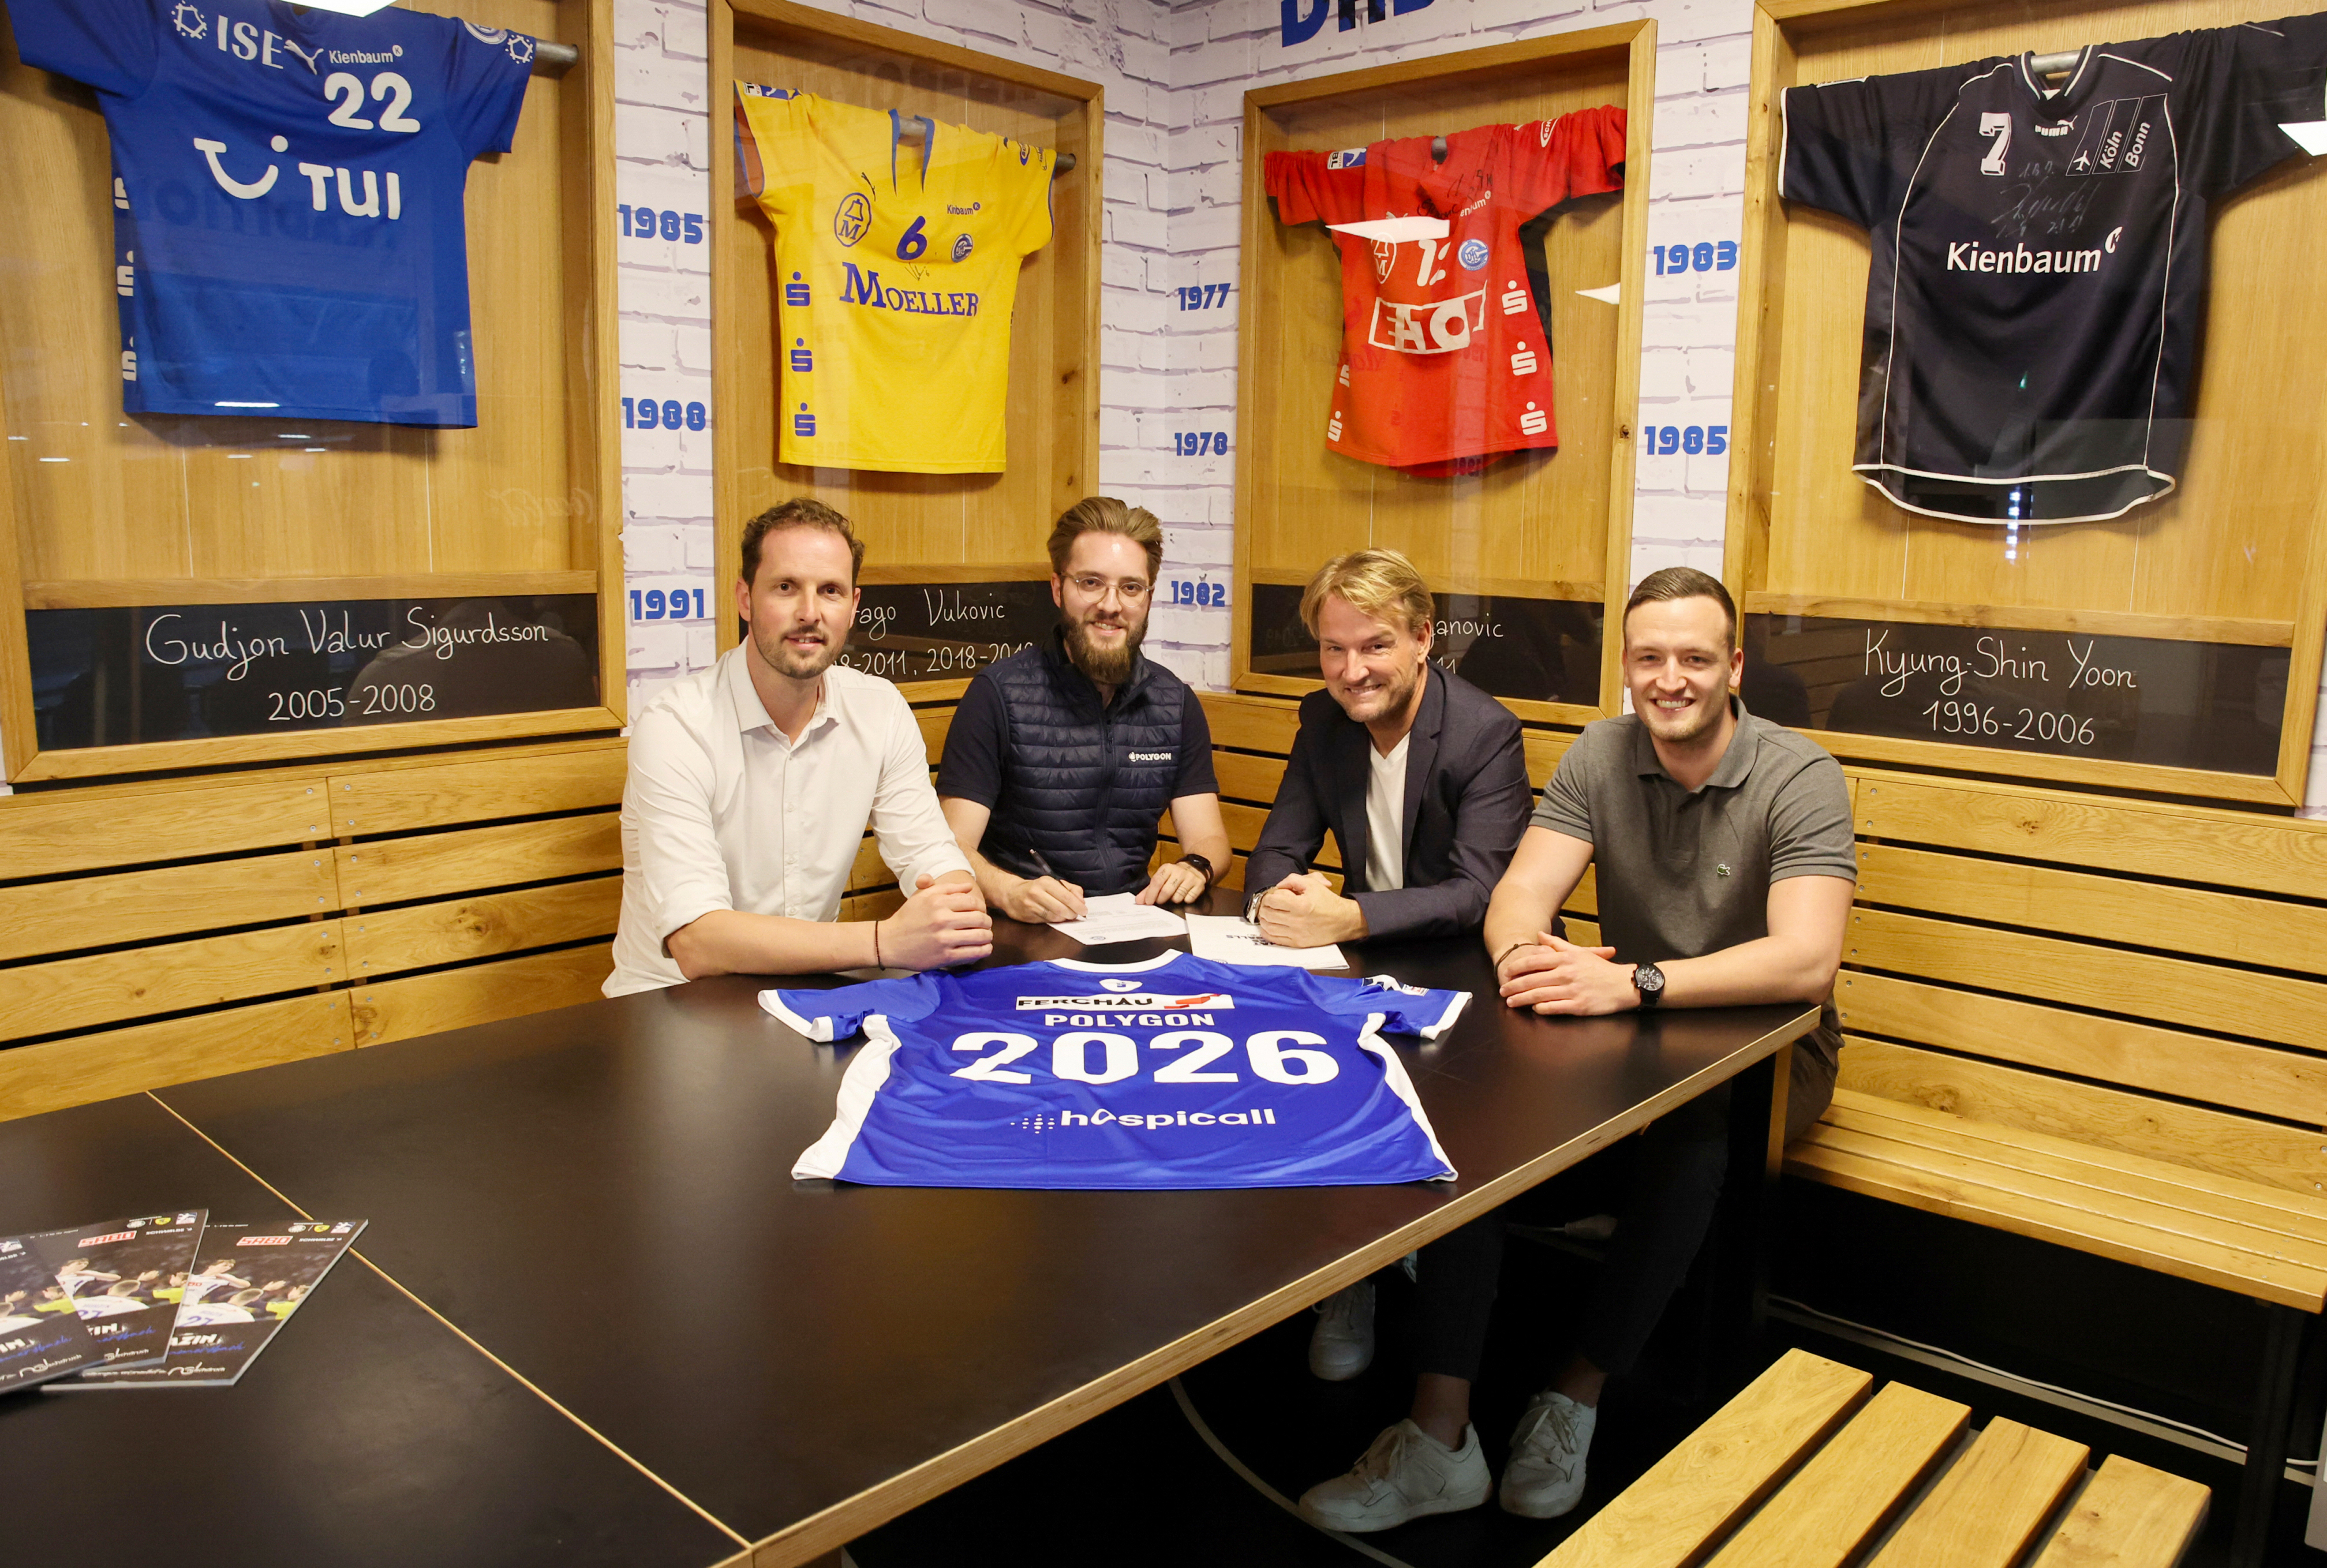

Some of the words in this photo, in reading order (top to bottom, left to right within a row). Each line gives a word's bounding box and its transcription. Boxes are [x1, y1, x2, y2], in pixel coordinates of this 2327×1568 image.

[217, 14, 283, 70] ISE
[328, 50, 394, 64] Kienbaum
[324, 72, 421, 133] 22
[1979, 112, 2011, 176] 7
[2099, 130, 2123, 169] Köln
[2124, 121, 2151, 167] Bonn
[298, 162, 401, 220] TUI
[619, 203, 703, 245] 1985
[896, 215, 927, 261] 6
[1653, 240, 1737, 275] 1983
[1946, 241, 2102, 274] Kienbaum
[839, 261, 979, 317] MOELLER
[1178, 283, 1231, 312] 1977
[622, 397, 706, 432] 1988
[1174, 432, 1228, 456] 1978
[1644, 425, 1728, 455] 1985
[629, 588, 705, 620] 1991
[924, 588, 1006, 627] Vukovic
[1171, 580, 1225, 608] 1982
[146, 613, 290, 682] Gudjon
[300, 609, 391, 655] Valur
[402, 607, 549, 660] Sigurdsson
[1865, 627, 2049, 698] Kyung-Shin
[2067, 639, 2137, 689] Yoon
[268, 683, 436, 721] 2005-2008
[1922, 701, 2096, 746] 1996-2006
[1136, 753, 1172, 761] POLYGON
[1045, 1013, 1215, 1027] POLYGON
[949, 1030, 1340, 1086] 2026
[1061, 1108, 1276, 1130] hospicall
[78, 1230, 137, 1248] SABO
[237, 1236, 293, 1246] SABO
